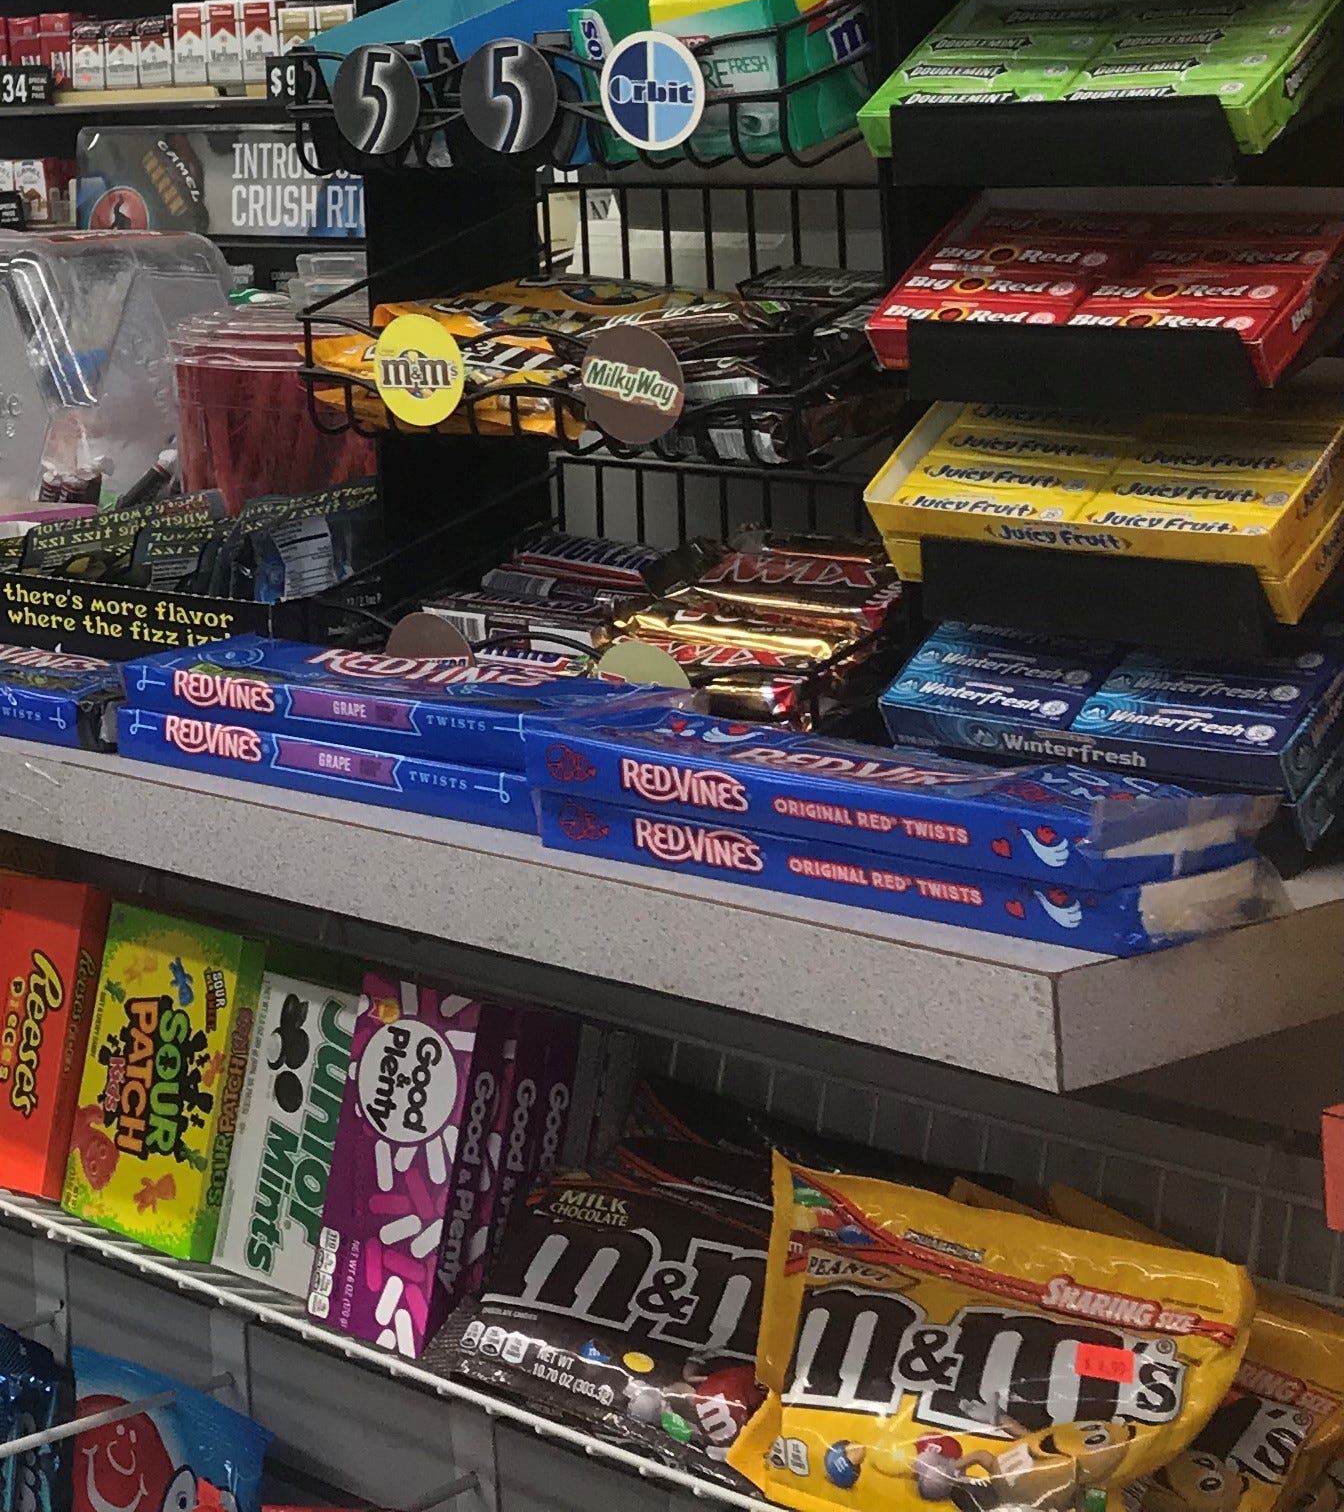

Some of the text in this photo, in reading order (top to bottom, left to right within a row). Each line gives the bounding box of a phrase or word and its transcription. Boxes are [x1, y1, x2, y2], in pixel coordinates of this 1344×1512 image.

[609, 75, 693, 105] Orbit
[908, 65, 1004, 79] DOUBLEMINT
[361, 47, 393, 153] 5
[156, 139, 200, 203] CAMEL
[232, 185, 365, 228] CRUSH RI
[906, 276, 1051, 295] Big Red
[1091, 282, 1245, 299] Big Red
[913, 495, 1033, 519] Juicy Fruit
[3, 582, 234, 628] there's more flavor
[8, 607, 76, 631] where
[82, 615, 123, 637] the
[129, 621, 179, 646] fizz
[332, 701, 367, 719] GRAPE
[425, 714, 486, 732] TWISTS
[919, 681, 1041, 711] Winterfresh
[1108, 709, 1247, 739] Winterfresh
[1002, 732, 1147, 768] Winterfresh
[318, 753, 351, 772] GRAPE
[409, 771, 468, 790] TWISTS
[773, 797, 853, 827] ORIGINAL
[903, 818, 981, 848] TWISTS
[788, 857, 867, 886] ORIGINAL
[916, 879, 994, 909] TWISTS
[12, 951, 62, 1118] Reese's
[116, 999, 160, 1153] PATCH
[146, 1010, 189, 1153] SOUR
[366, 1025, 411, 1133] Plenty
[402, 1037, 443, 1134] Good
[288, 996, 358, 1249] Junior
[244, 1116, 301, 1276] Mints
[550, 1202, 629, 1228] CHOCOLATE
[559, 1190, 628, 1214] MILK
[807, 1255, 893, 1283] PEANUT
[1043, 1277, 1196, 1333] SHARING SIZE
